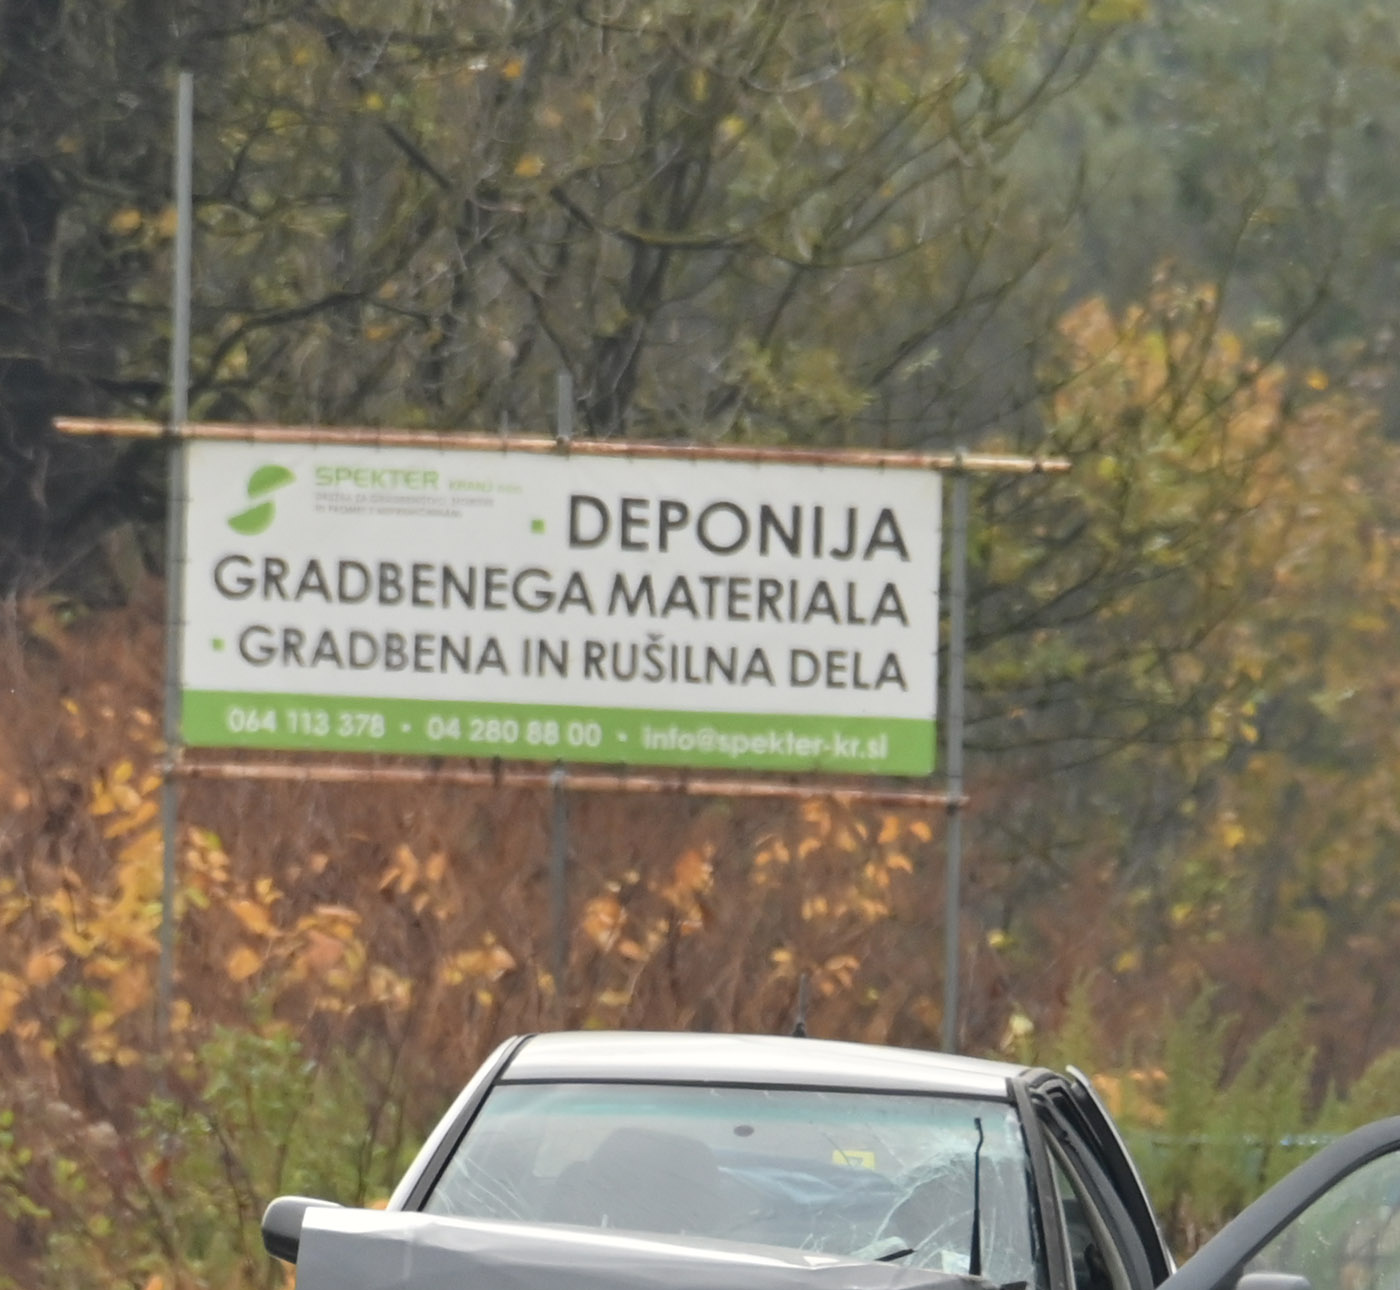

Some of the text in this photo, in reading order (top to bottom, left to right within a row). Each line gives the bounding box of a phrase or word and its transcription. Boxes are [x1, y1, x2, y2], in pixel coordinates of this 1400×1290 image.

[314, 466, 440, 490] SPEKTER
[568, 494, 911, 562] DEPONIJA
[213, 554, 910, 627] GRADBENEGA MATERIALA
[238, 624, 909, 692] GRADBENA IN RUŠILNA DELA
[227, 707, 277, 733] 064
[286, 710, 330, 737] 113
[338, 713, 386, 739] 378
[426, 715, 461, 740] 04
[469, 718, 519, 744] 280
[526, 719, 560, 745] 88
[567, 721, 602, 748] 00
